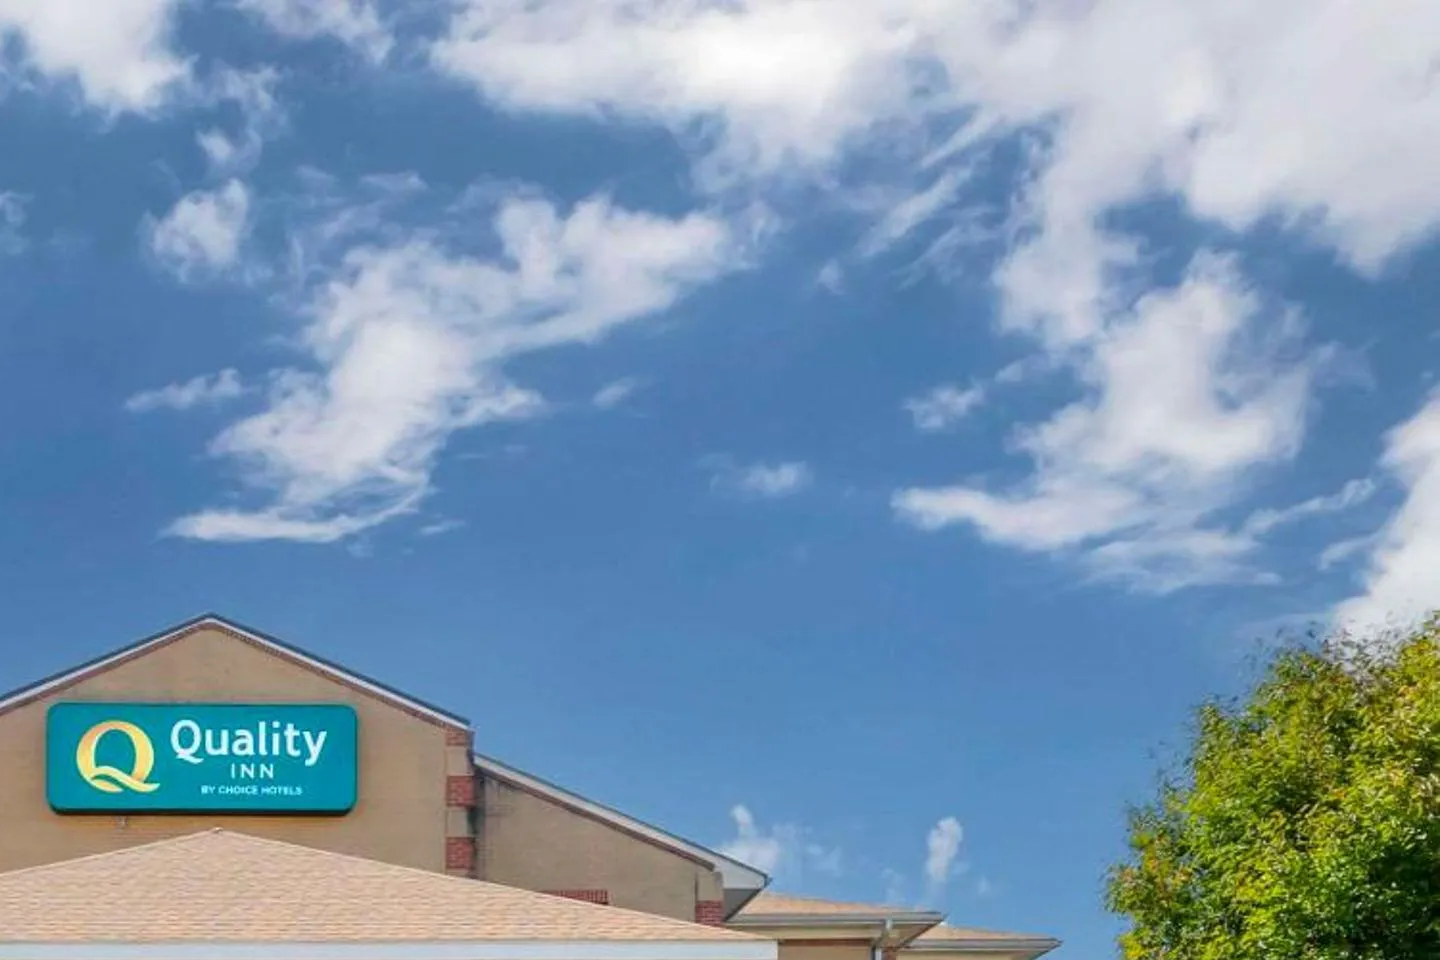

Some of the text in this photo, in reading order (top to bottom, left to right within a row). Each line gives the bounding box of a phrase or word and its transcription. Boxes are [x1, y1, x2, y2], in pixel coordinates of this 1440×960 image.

[76, 720, 160, 792] Q
[170, 719, 327, 766] Quality
[231, 763, 274, 779] INN
[201, 785, 302, 795] BY CHOICE HOTELS
